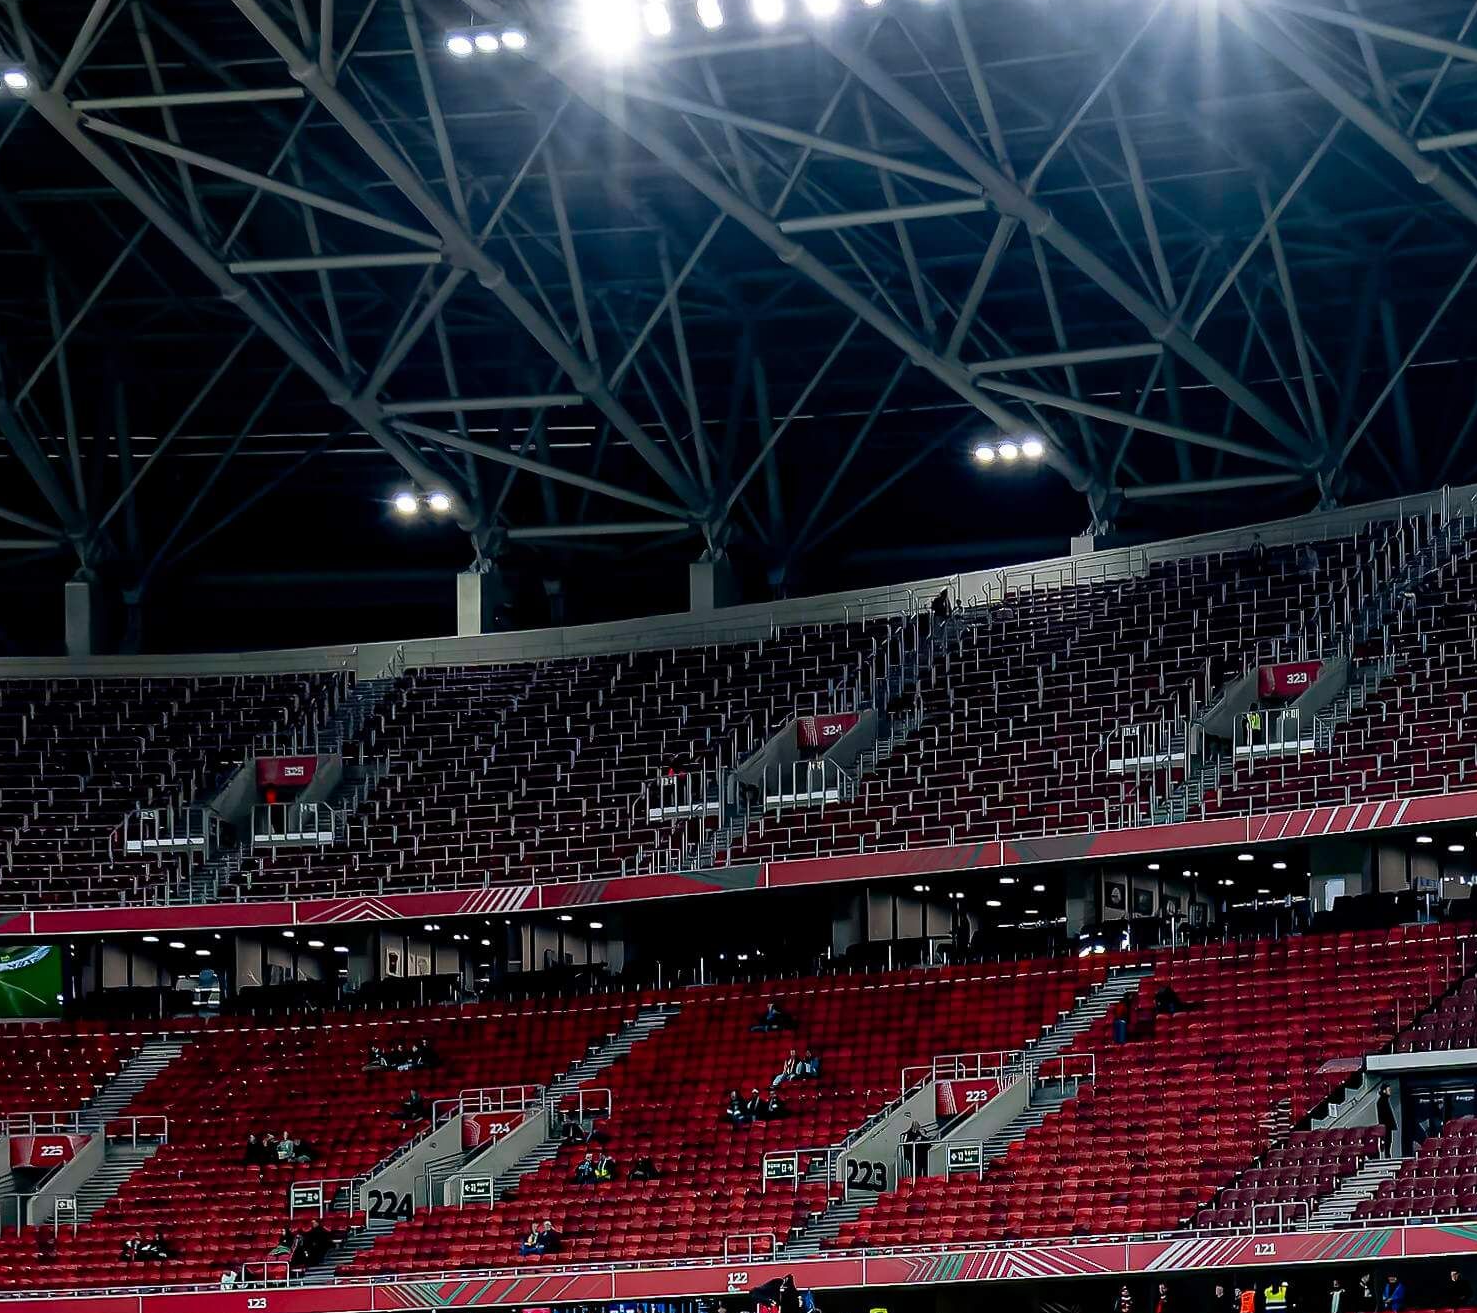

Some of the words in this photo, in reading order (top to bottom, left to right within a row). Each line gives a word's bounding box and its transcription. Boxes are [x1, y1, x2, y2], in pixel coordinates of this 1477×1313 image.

[1287, 673, 1307, 684] 323
[966, 1091, 987, 1102] 223
[847, 1159, 887, 1192] 223
[368, 1189, 413, 1221] 224
[1254, 1243, 1276, 1256] 121
[728, 1272, 748, 1285] 122
[248, 1298, 267, 1309] 123
